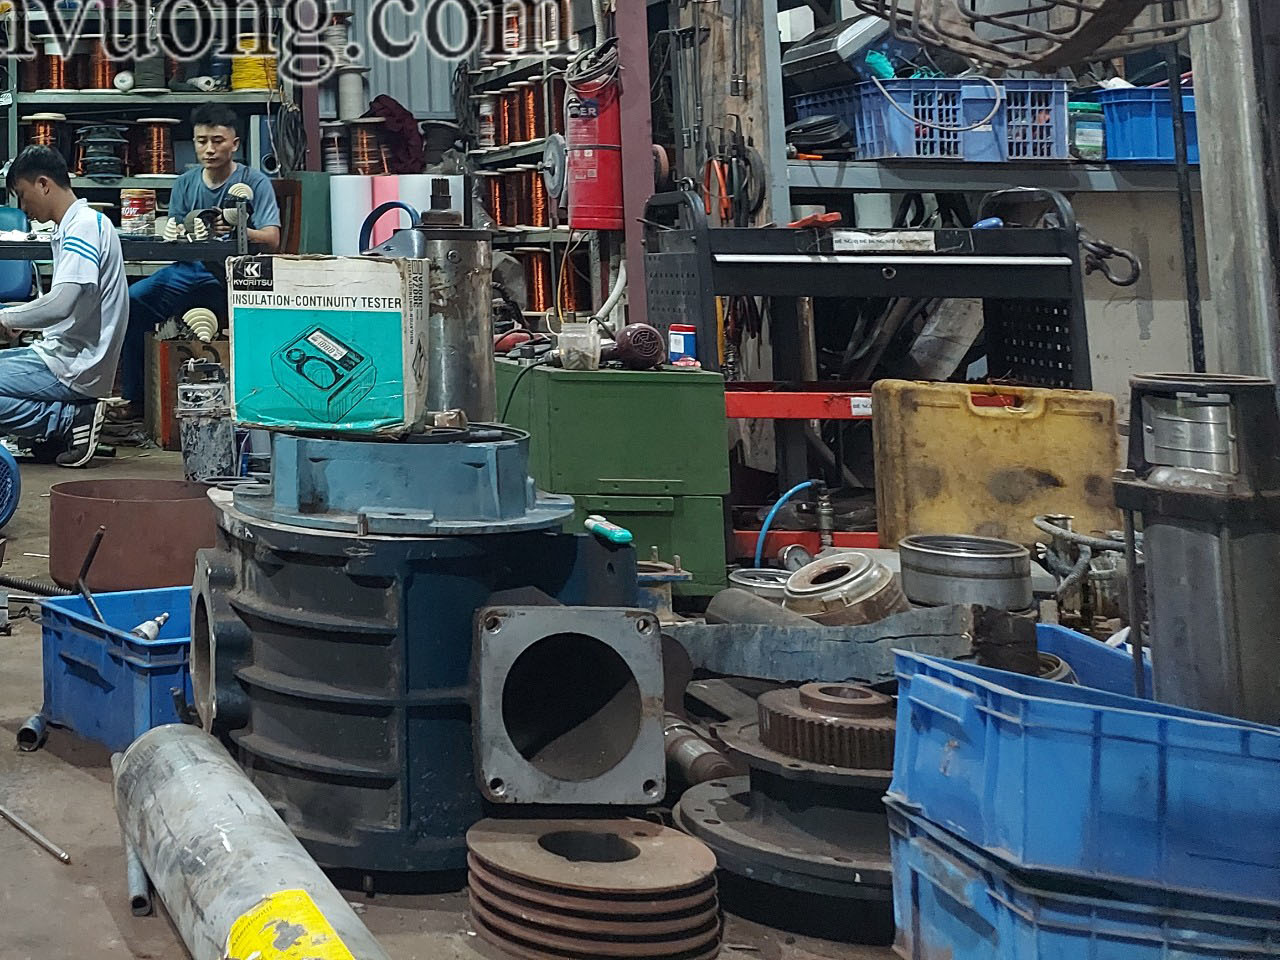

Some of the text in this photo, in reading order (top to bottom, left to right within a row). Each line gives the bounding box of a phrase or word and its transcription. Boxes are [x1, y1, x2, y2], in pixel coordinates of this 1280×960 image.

[233, 278, 273, 287] KYORITSU
[232, 293, 402, 309] INSULATION-CONTINUITY TESTER
